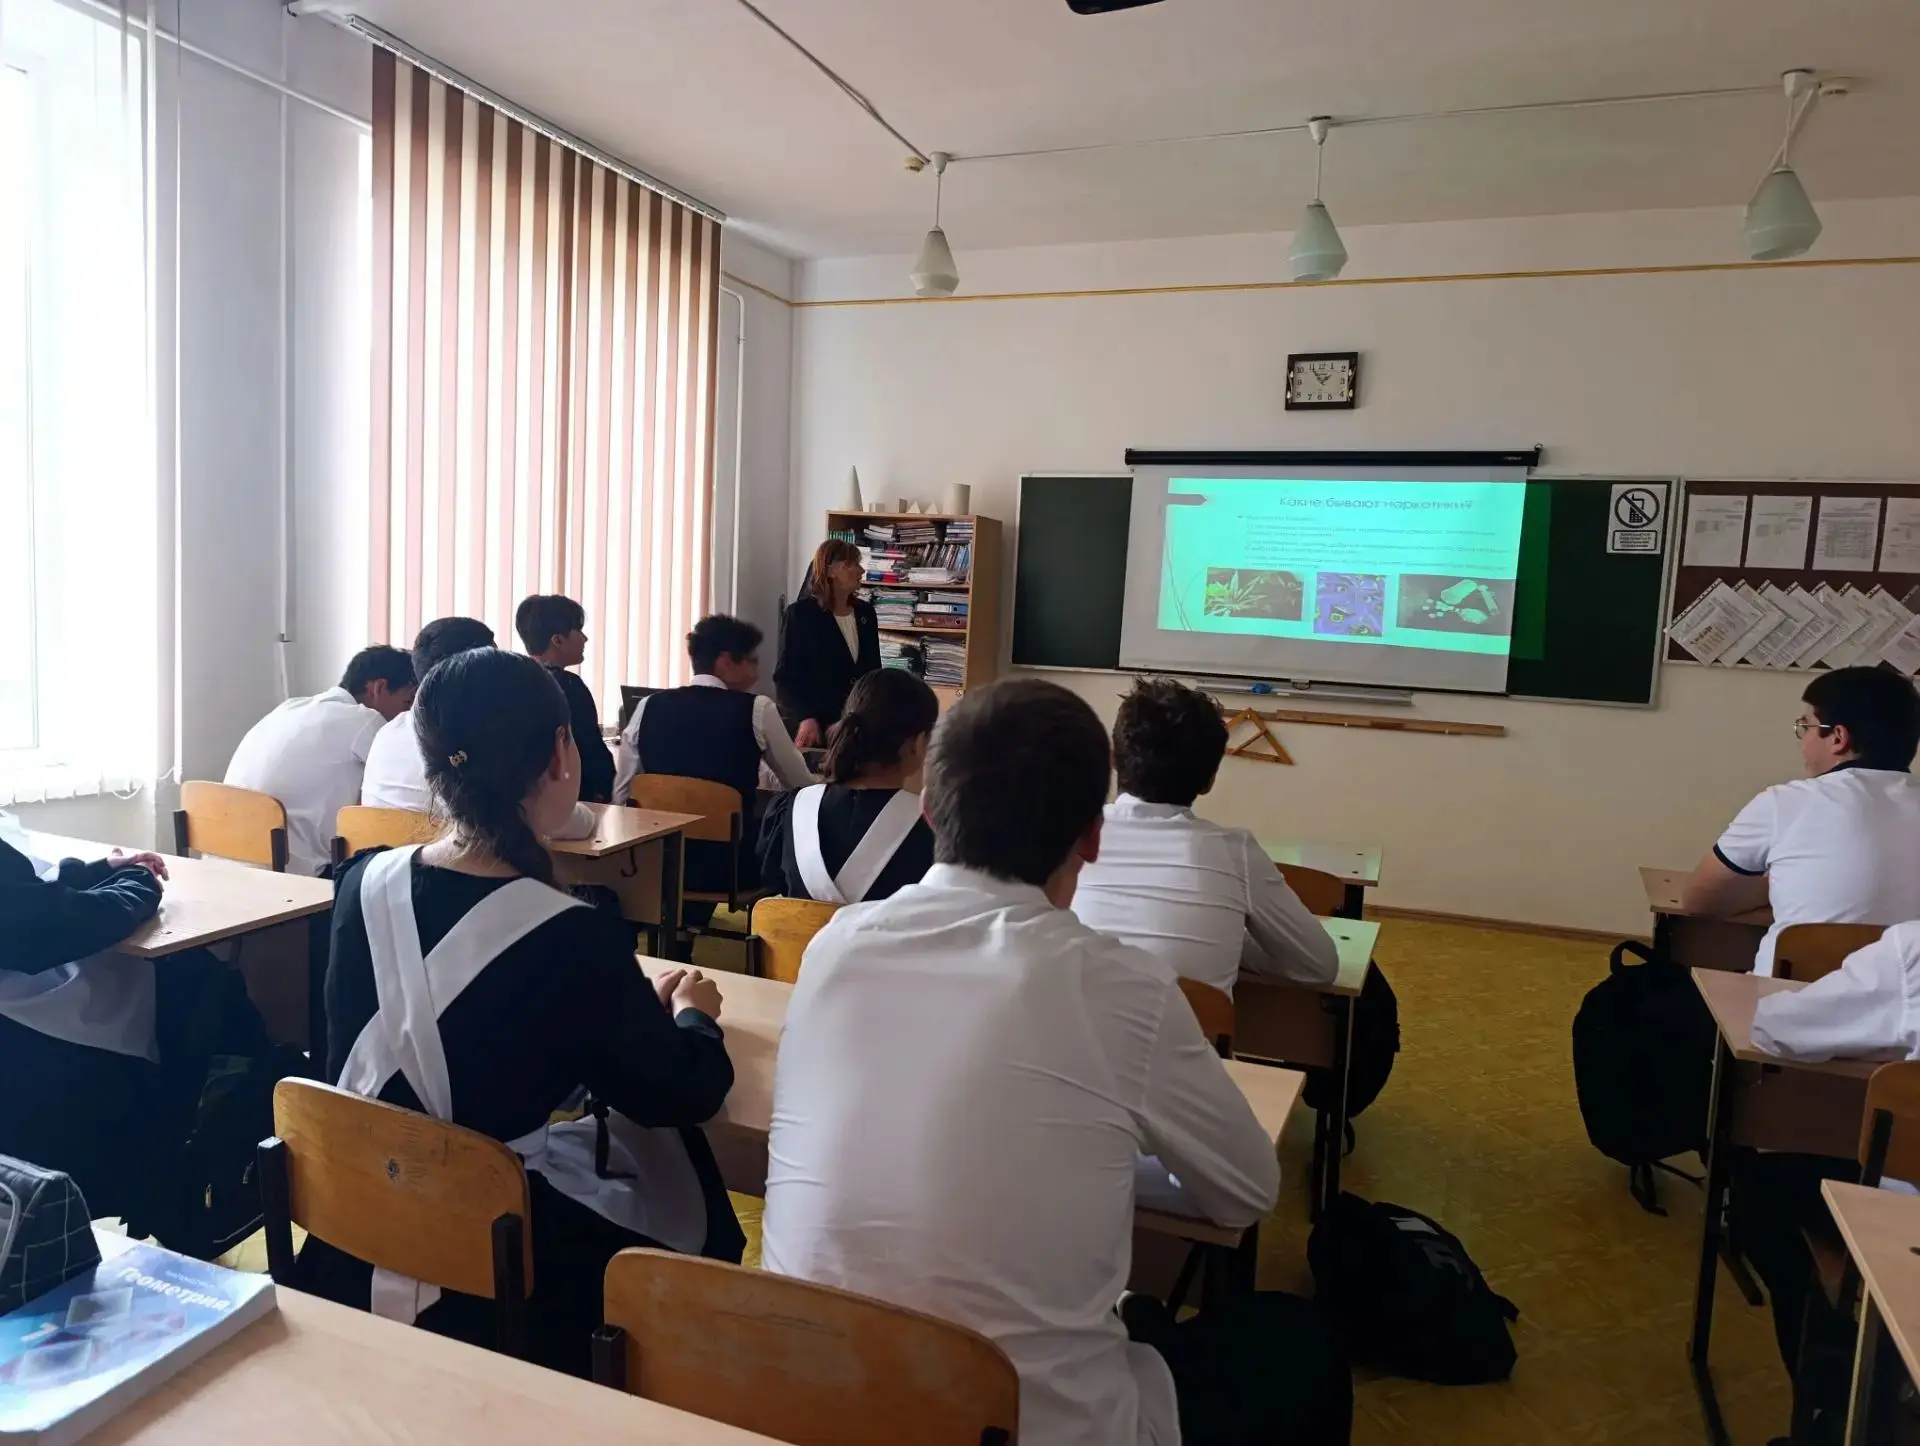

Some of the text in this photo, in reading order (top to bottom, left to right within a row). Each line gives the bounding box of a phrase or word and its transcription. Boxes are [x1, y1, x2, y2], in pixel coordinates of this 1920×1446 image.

[1279, 496, 1322, 508] Какие
[1326, 497, 1379, 509] бывают
[117, 1267, 231, 1310] Геометрия
